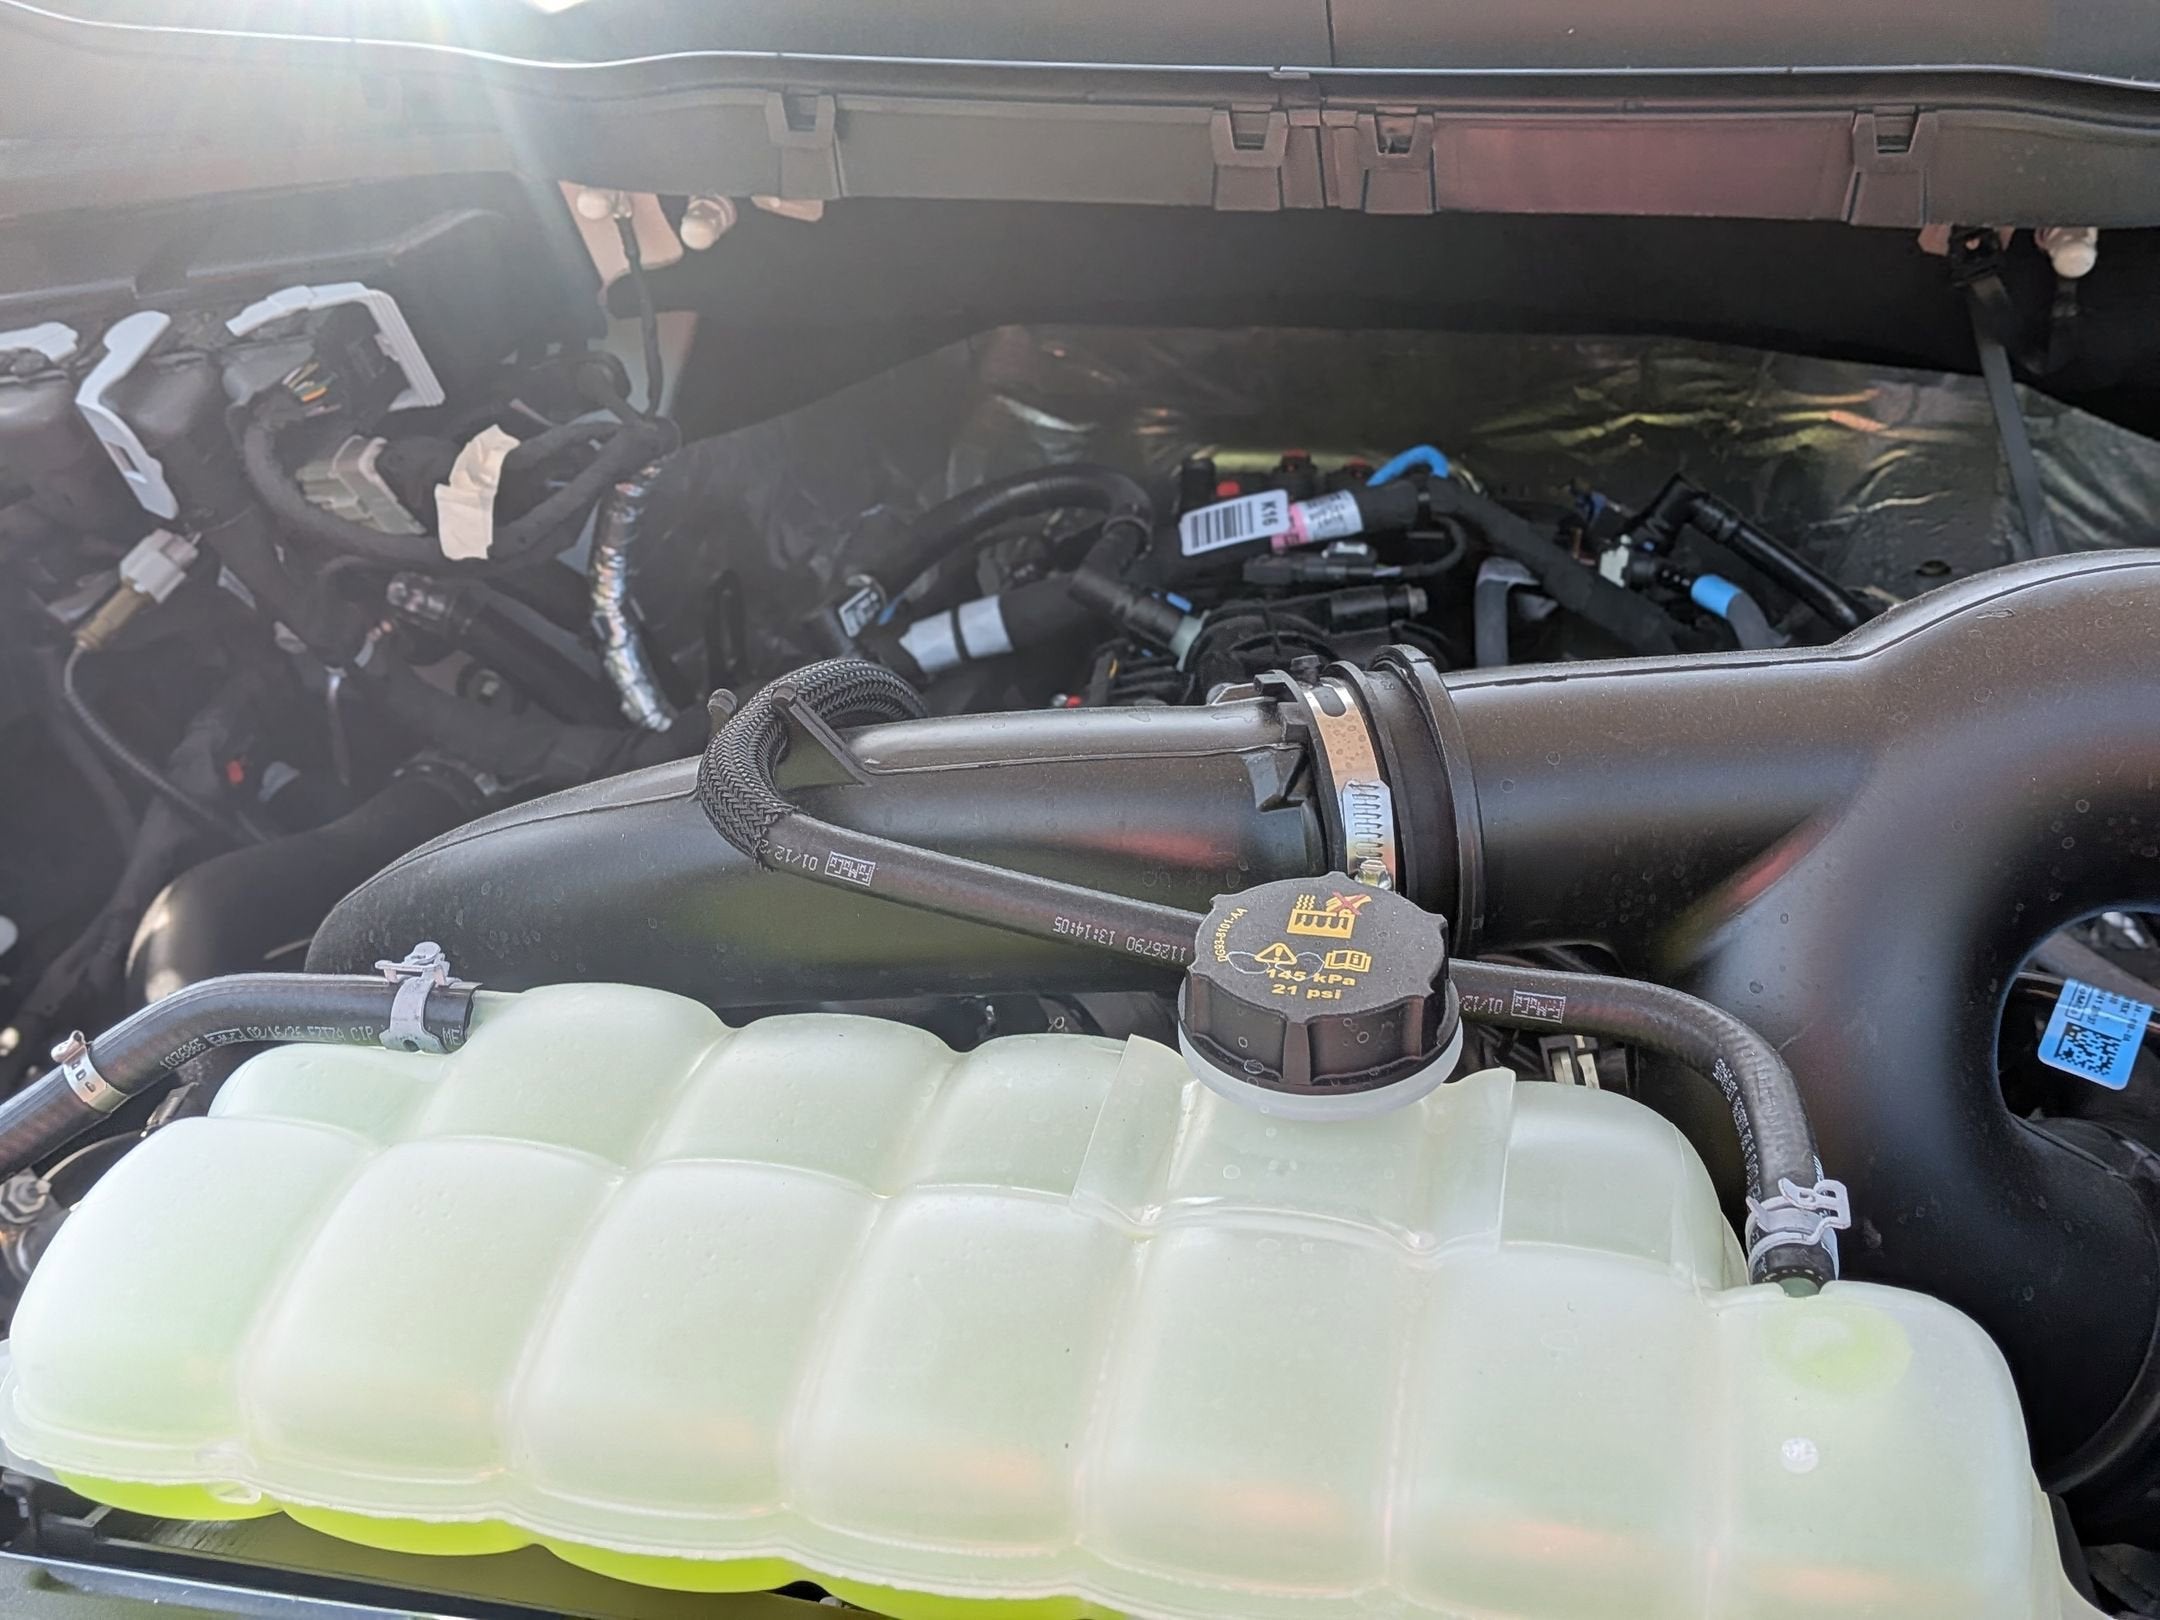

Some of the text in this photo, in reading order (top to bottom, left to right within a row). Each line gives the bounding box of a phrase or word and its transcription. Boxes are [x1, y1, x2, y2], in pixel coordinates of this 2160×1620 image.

[1261, 500, 1279, 527] K16
[1053, 916, 1187, 963] 1126790 13:14:05
[1213, 907, 1249, 963] DG93-8101-AA
[1266, 968, 1356, 986] 145 kPa
[1271, 984, 1341, 1000] 21 psi
[350, 1025, 375, 1042] CIP
[442, 1025, 464, 1046] ME
